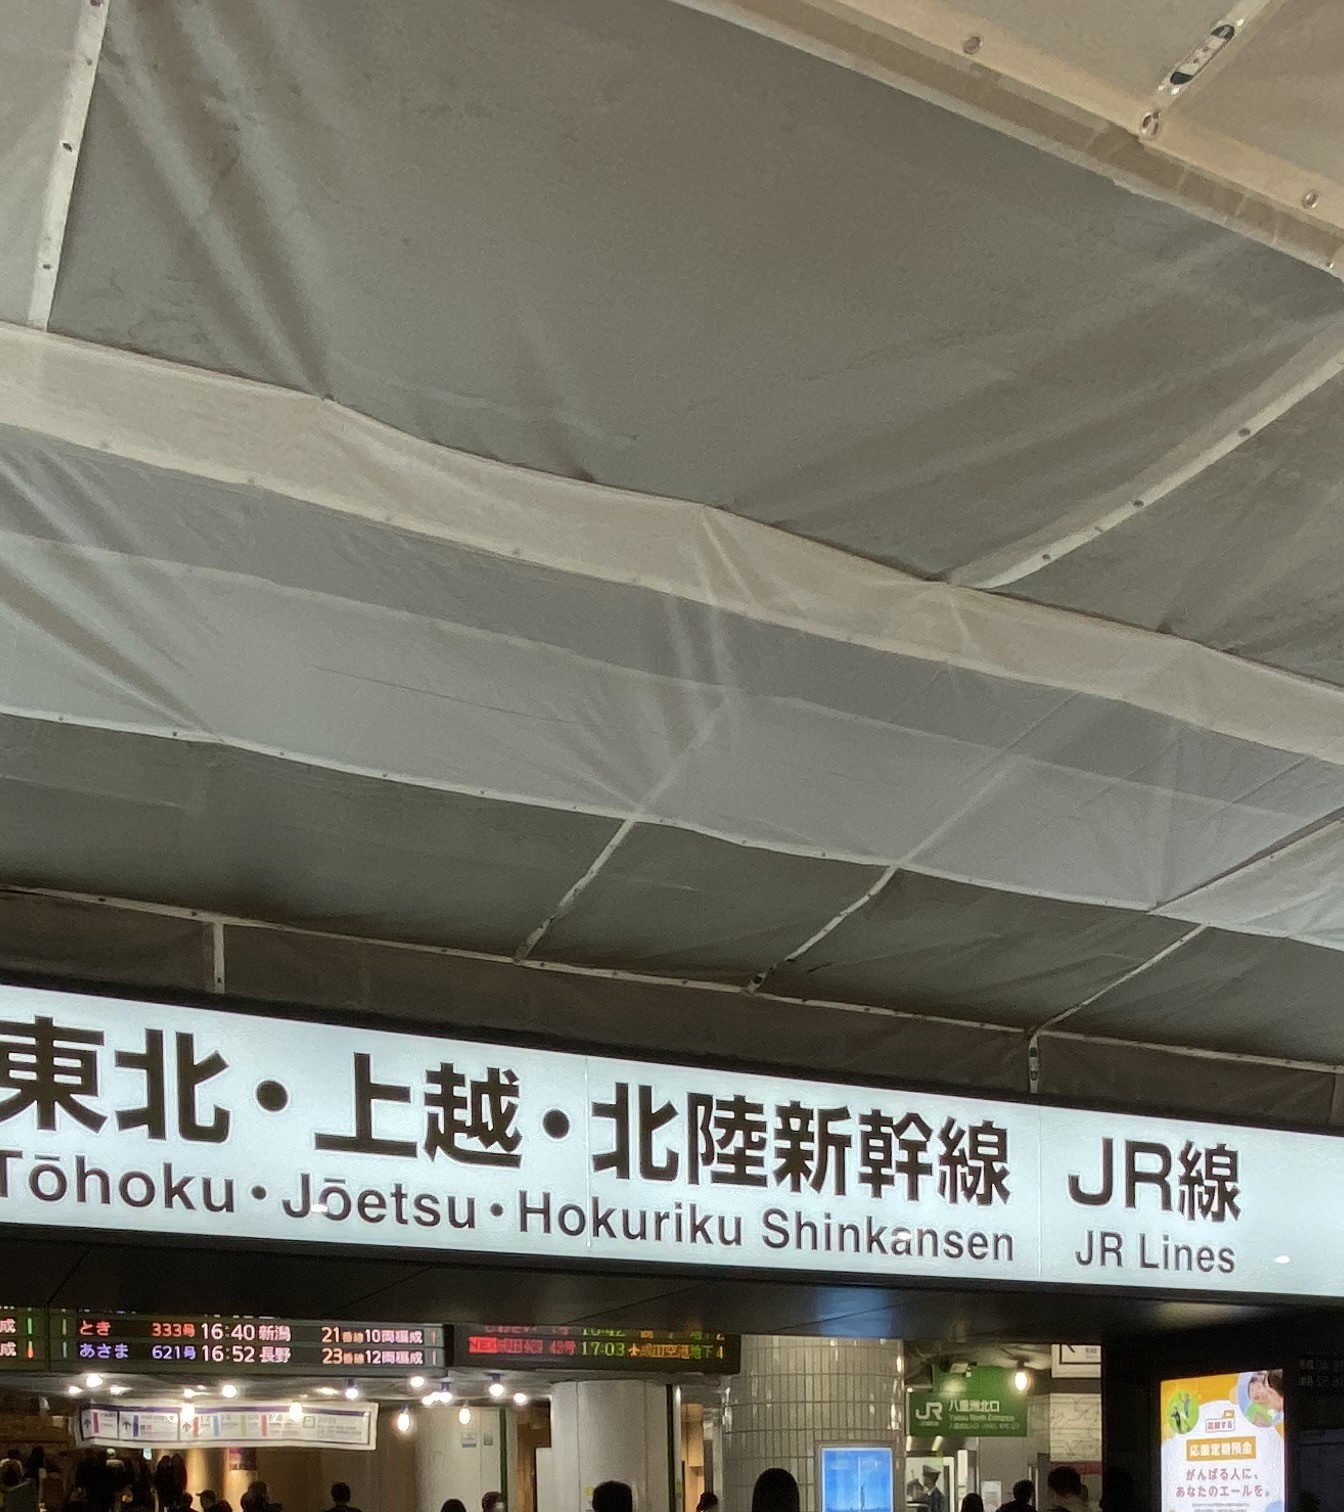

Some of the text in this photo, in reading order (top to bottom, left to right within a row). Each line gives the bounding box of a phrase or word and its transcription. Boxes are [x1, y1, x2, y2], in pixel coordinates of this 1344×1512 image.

[1067, 1136, 1243, 1224] JR線
[761, 1207, 1015, 1262] Shinkansen
[1074, 1230, 1236, 1274] JR Lines
[79, 1319, 111, 1337] とき
[151, 1322, 196, 1338] 333号
[201, 1322, 256, 1341] 16:40
[79, 1342, 129, 1360] あさま
[151, 1344, 196, 1361] 621号
[201, 1344, 256, 1363] 16:52
[258, 1346, 292, 1364] 長野
[581, 1341, 626, 1357] 17:03
[916, 1402, 943, 1421] JR
